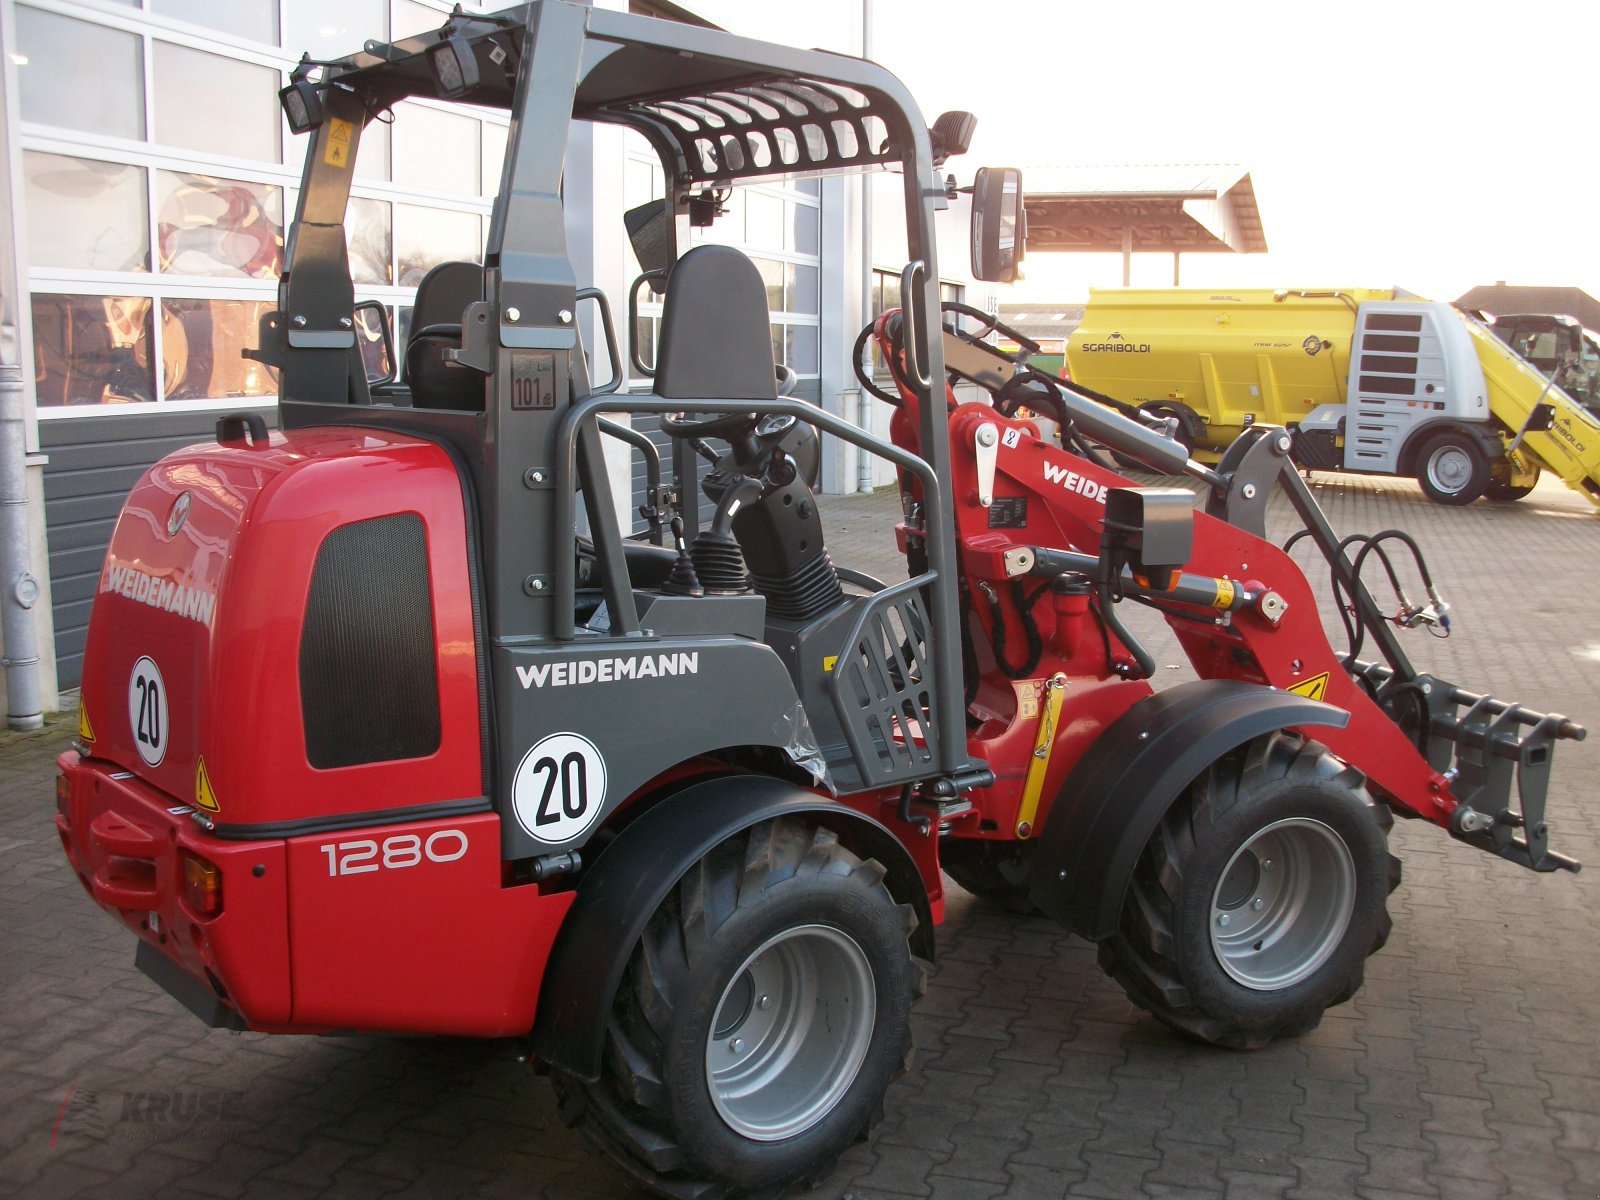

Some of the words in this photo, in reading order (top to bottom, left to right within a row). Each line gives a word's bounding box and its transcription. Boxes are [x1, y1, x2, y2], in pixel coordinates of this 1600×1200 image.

[1082, 343, 1151, 353] SGARIBOLDI
[515, 377, 541, 406] 101
[108, 563, 215, 625] WEIDEMANN
[516, 652, 699, 689] WEIDEMANN
[137, 675, 160, 748] 20
[533, 751, 587, 827] 20
[320, 829, 469, 877] 1280
